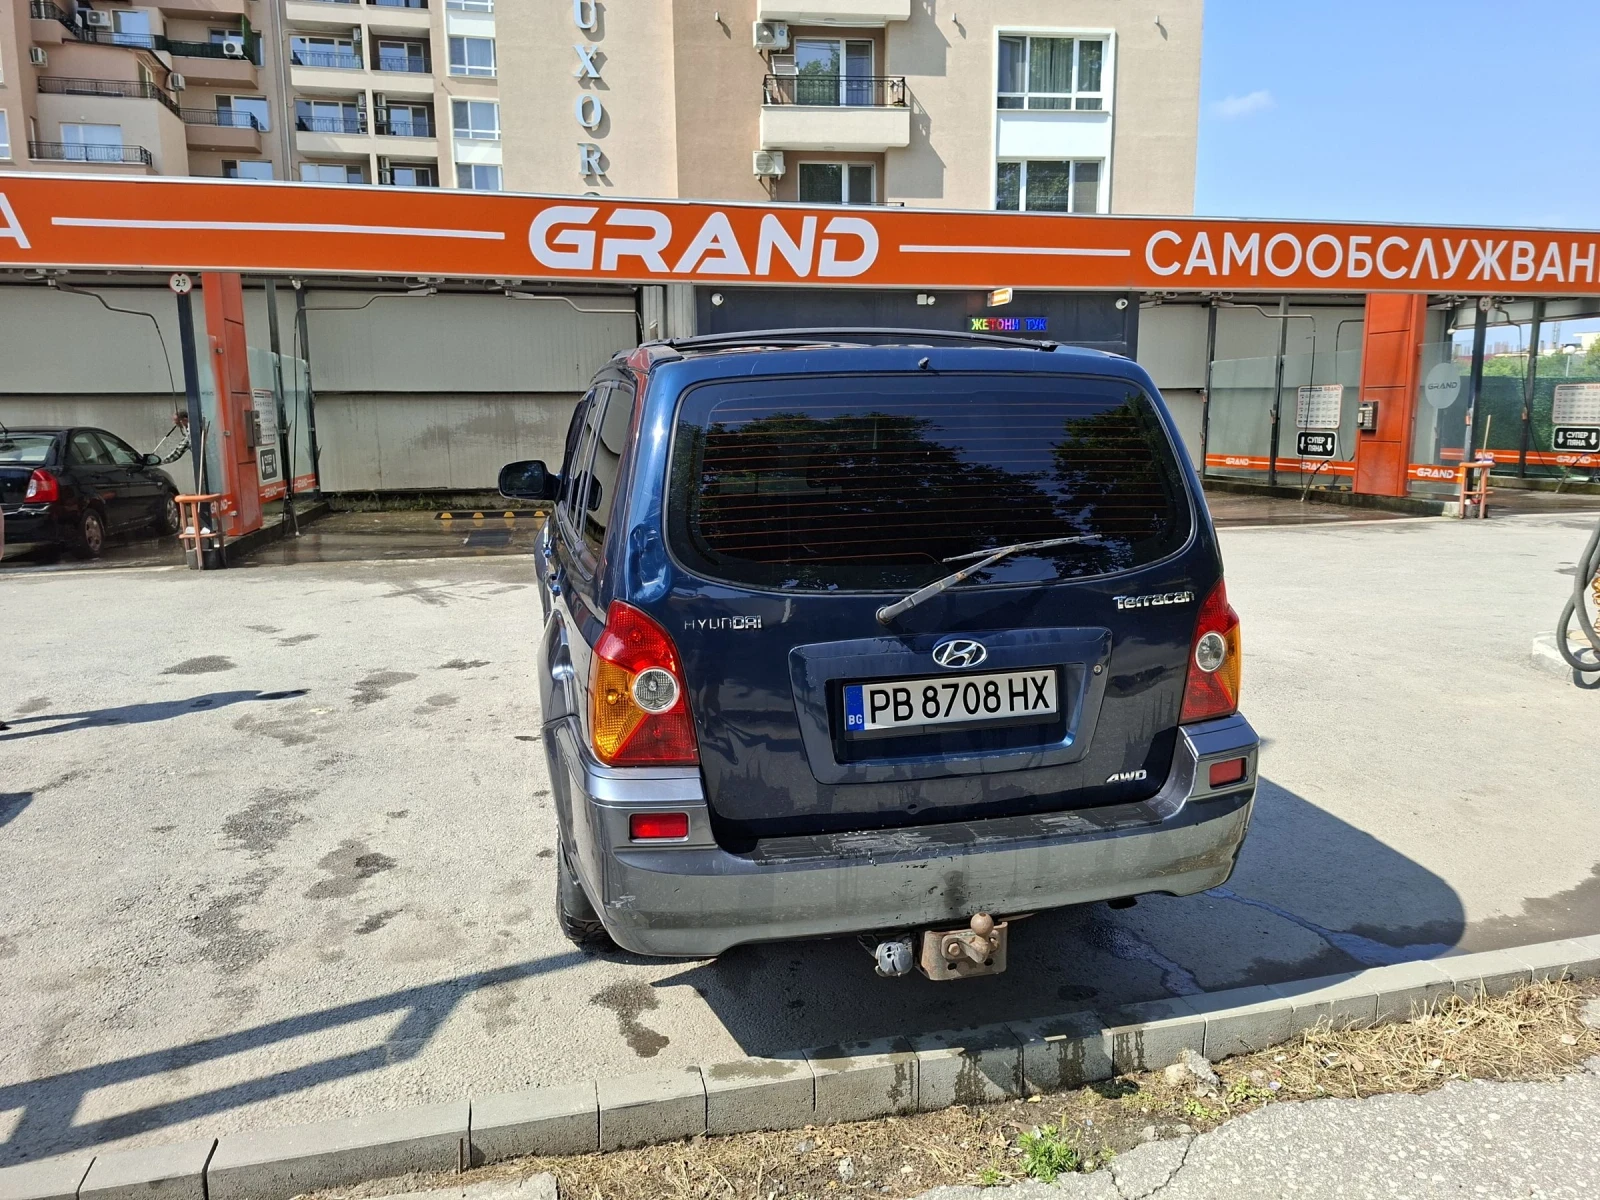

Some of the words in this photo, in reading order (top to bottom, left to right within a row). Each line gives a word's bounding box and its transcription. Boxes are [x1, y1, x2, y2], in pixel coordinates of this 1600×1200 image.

[572, 0, 604, 196] UXOR
[528, 206, 880, 278] GRAND
[1145, 229, 1600, 283] САМООБСЛУЖВАН
[971, 318, 1020, 331] ЖЕТОНИ
[1025, 318, 1047, 331] ТУК
[1427, 381, 1458, 390] GRAND
[1307, 436, 1326, 444] СУПЕР
[1566, 431, 1589, 439] СУПЕР
[1225, 457, 1249, 466] GRAND
[1556, 455, 1592, 465] GRAND
[1416, 467, 1454, 479] GRAND
[1112, 590, 1195, 609] Terracan
[684, 614, 762, 630] HYUNDAI
[869, 687, 914, 724] PB
[922, 680, 1001, 719] 8708
[1007, 675, 1051, 712] HX
[848, 714, 863, 725] BG
[1106, 769, 1147, 783] AWD
